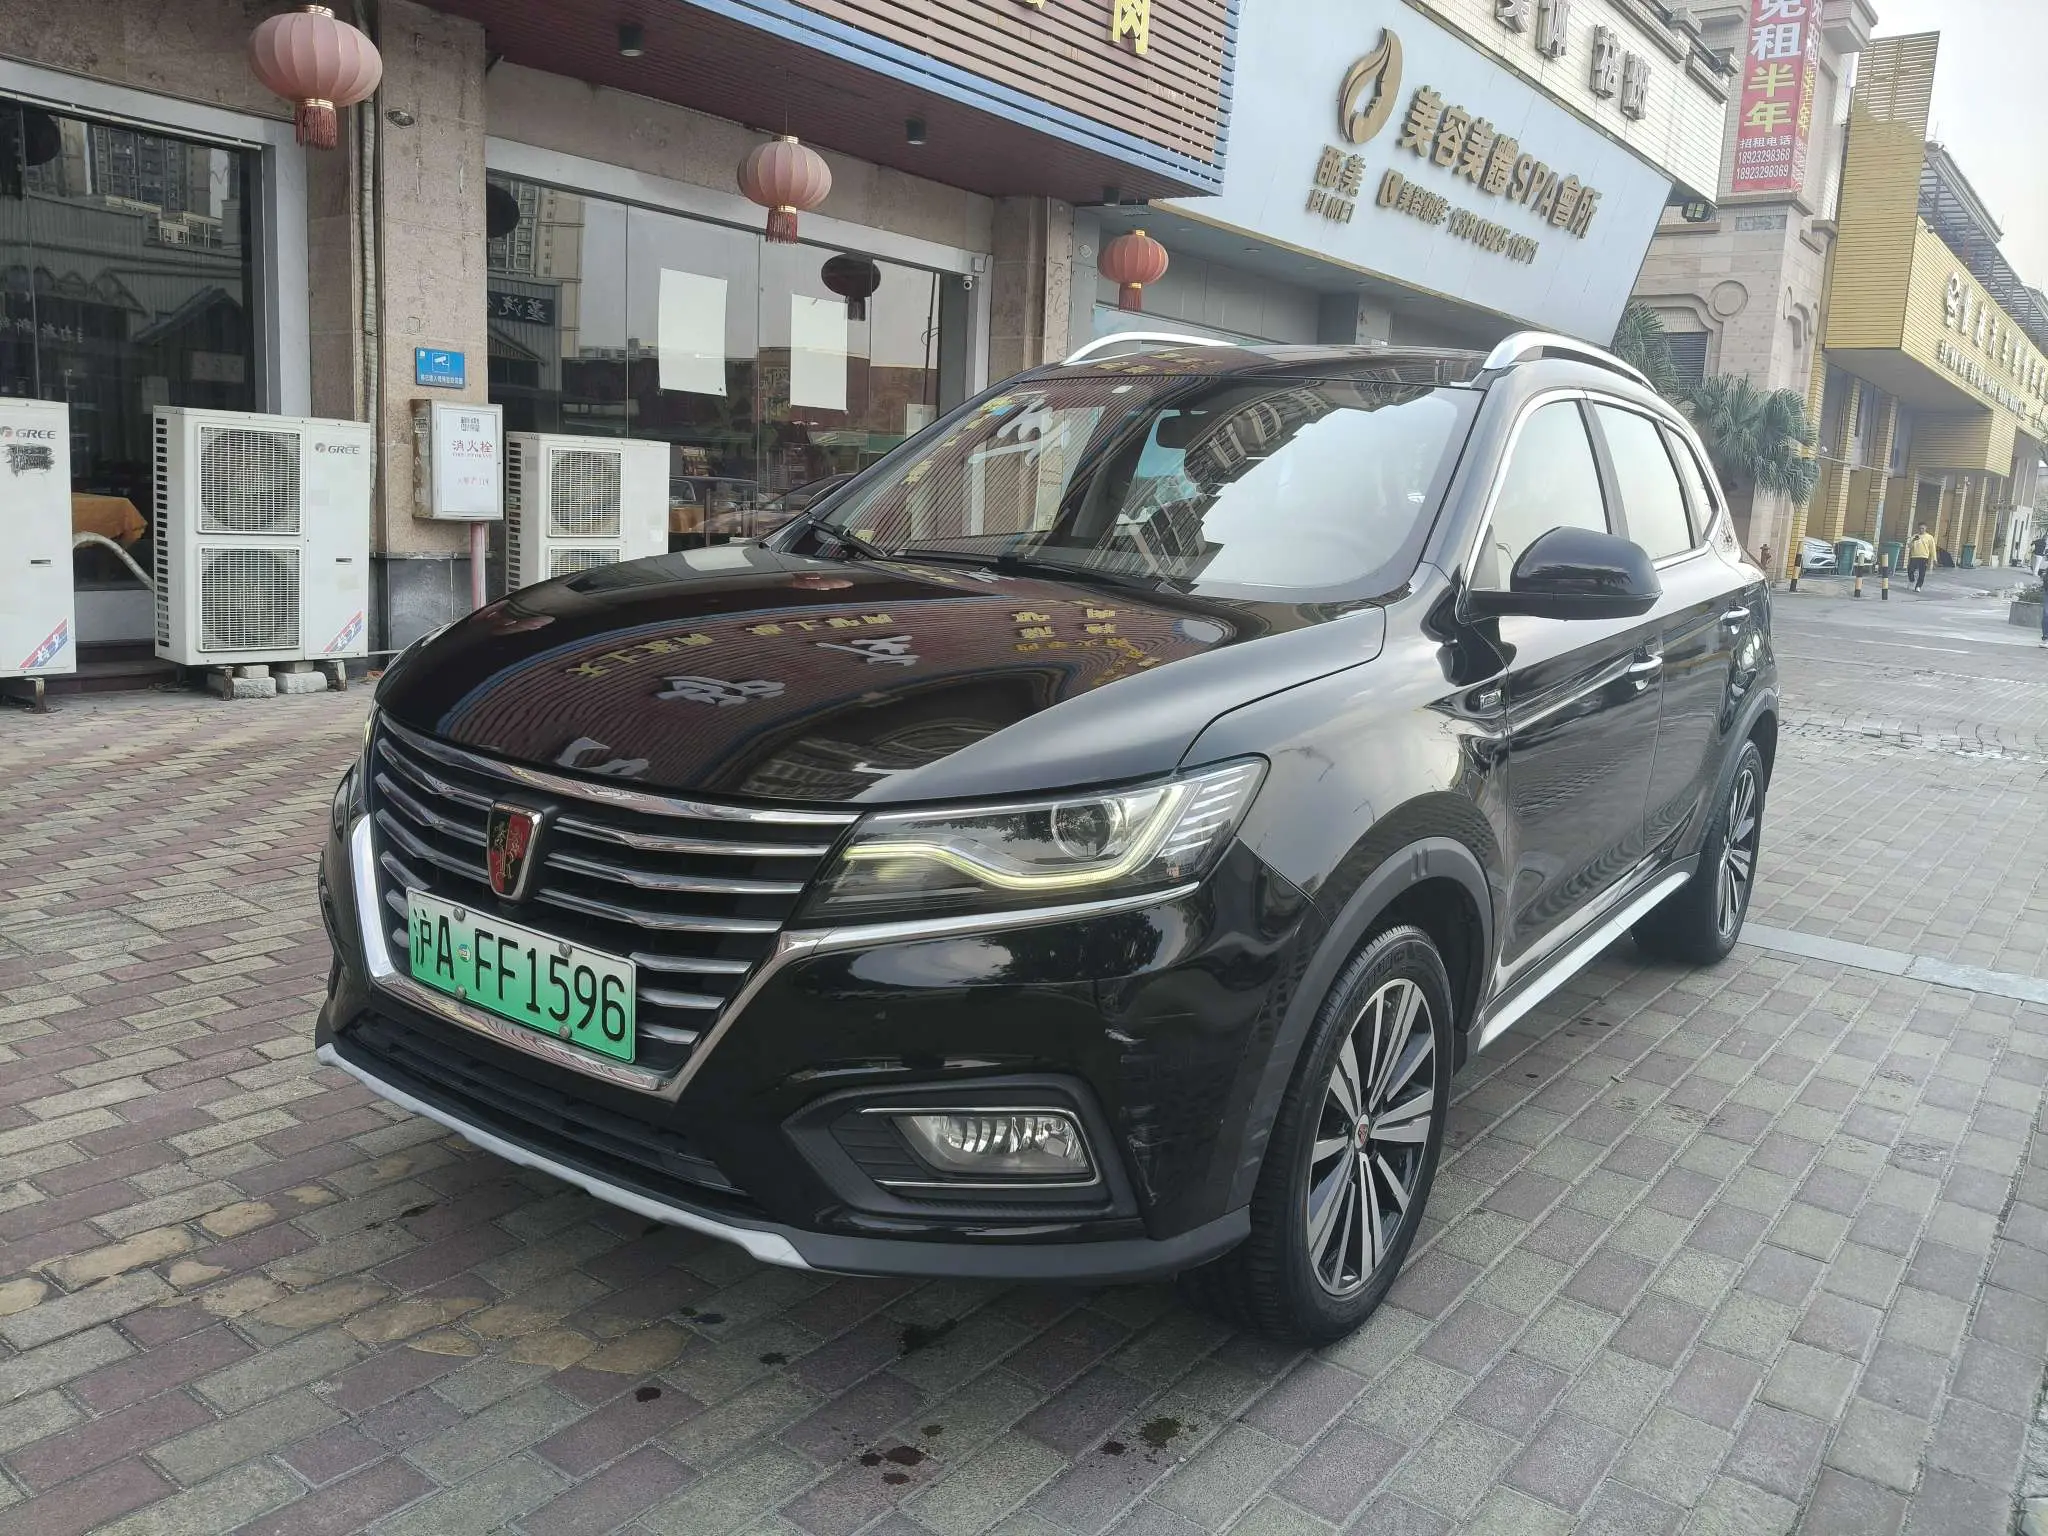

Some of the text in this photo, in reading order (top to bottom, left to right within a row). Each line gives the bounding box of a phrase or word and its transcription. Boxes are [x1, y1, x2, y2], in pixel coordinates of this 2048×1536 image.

[1739, 134, 1792, 149] 招租电话
[1738, 148, 1792, 165] 18923298368
[1736, 164, 1790, 180] 18923298369
[16, 428, 57, 440] GREE
[328, 444, 361, 455] GREE
[451, 440, 493, 453] 消火栓
[413, 908, 627, 1043] 沪A FF1596
